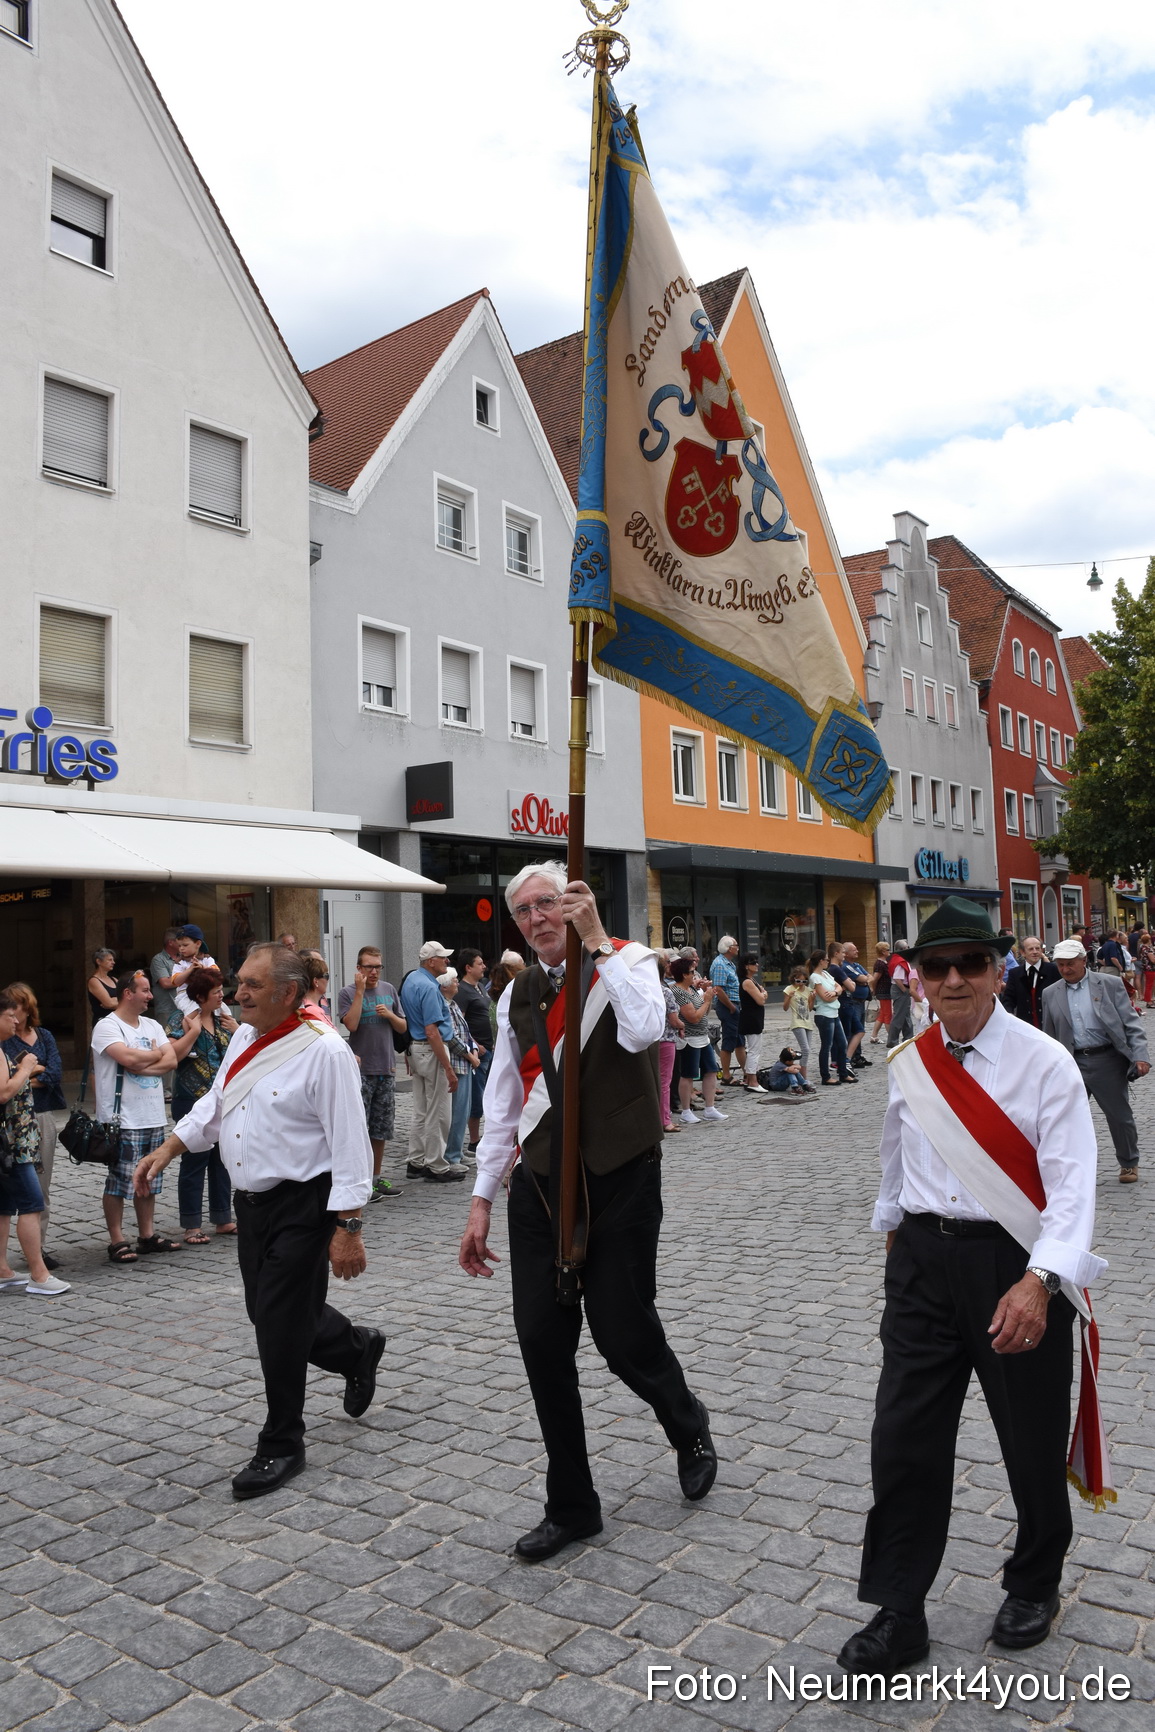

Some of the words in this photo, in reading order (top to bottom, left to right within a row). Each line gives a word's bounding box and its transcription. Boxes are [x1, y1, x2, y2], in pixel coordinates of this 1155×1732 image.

[569, 551, 608, 596] 1932
[708, 587, 725, 610] u.
[411, 799, 444, 815] s.Oliver
[916, 847, 960, 880] Eilles
[0, 892, 24, 903] SCHUH
[31, 888, 52, 899] FRIES
[354, 893, 361, 901] 29
